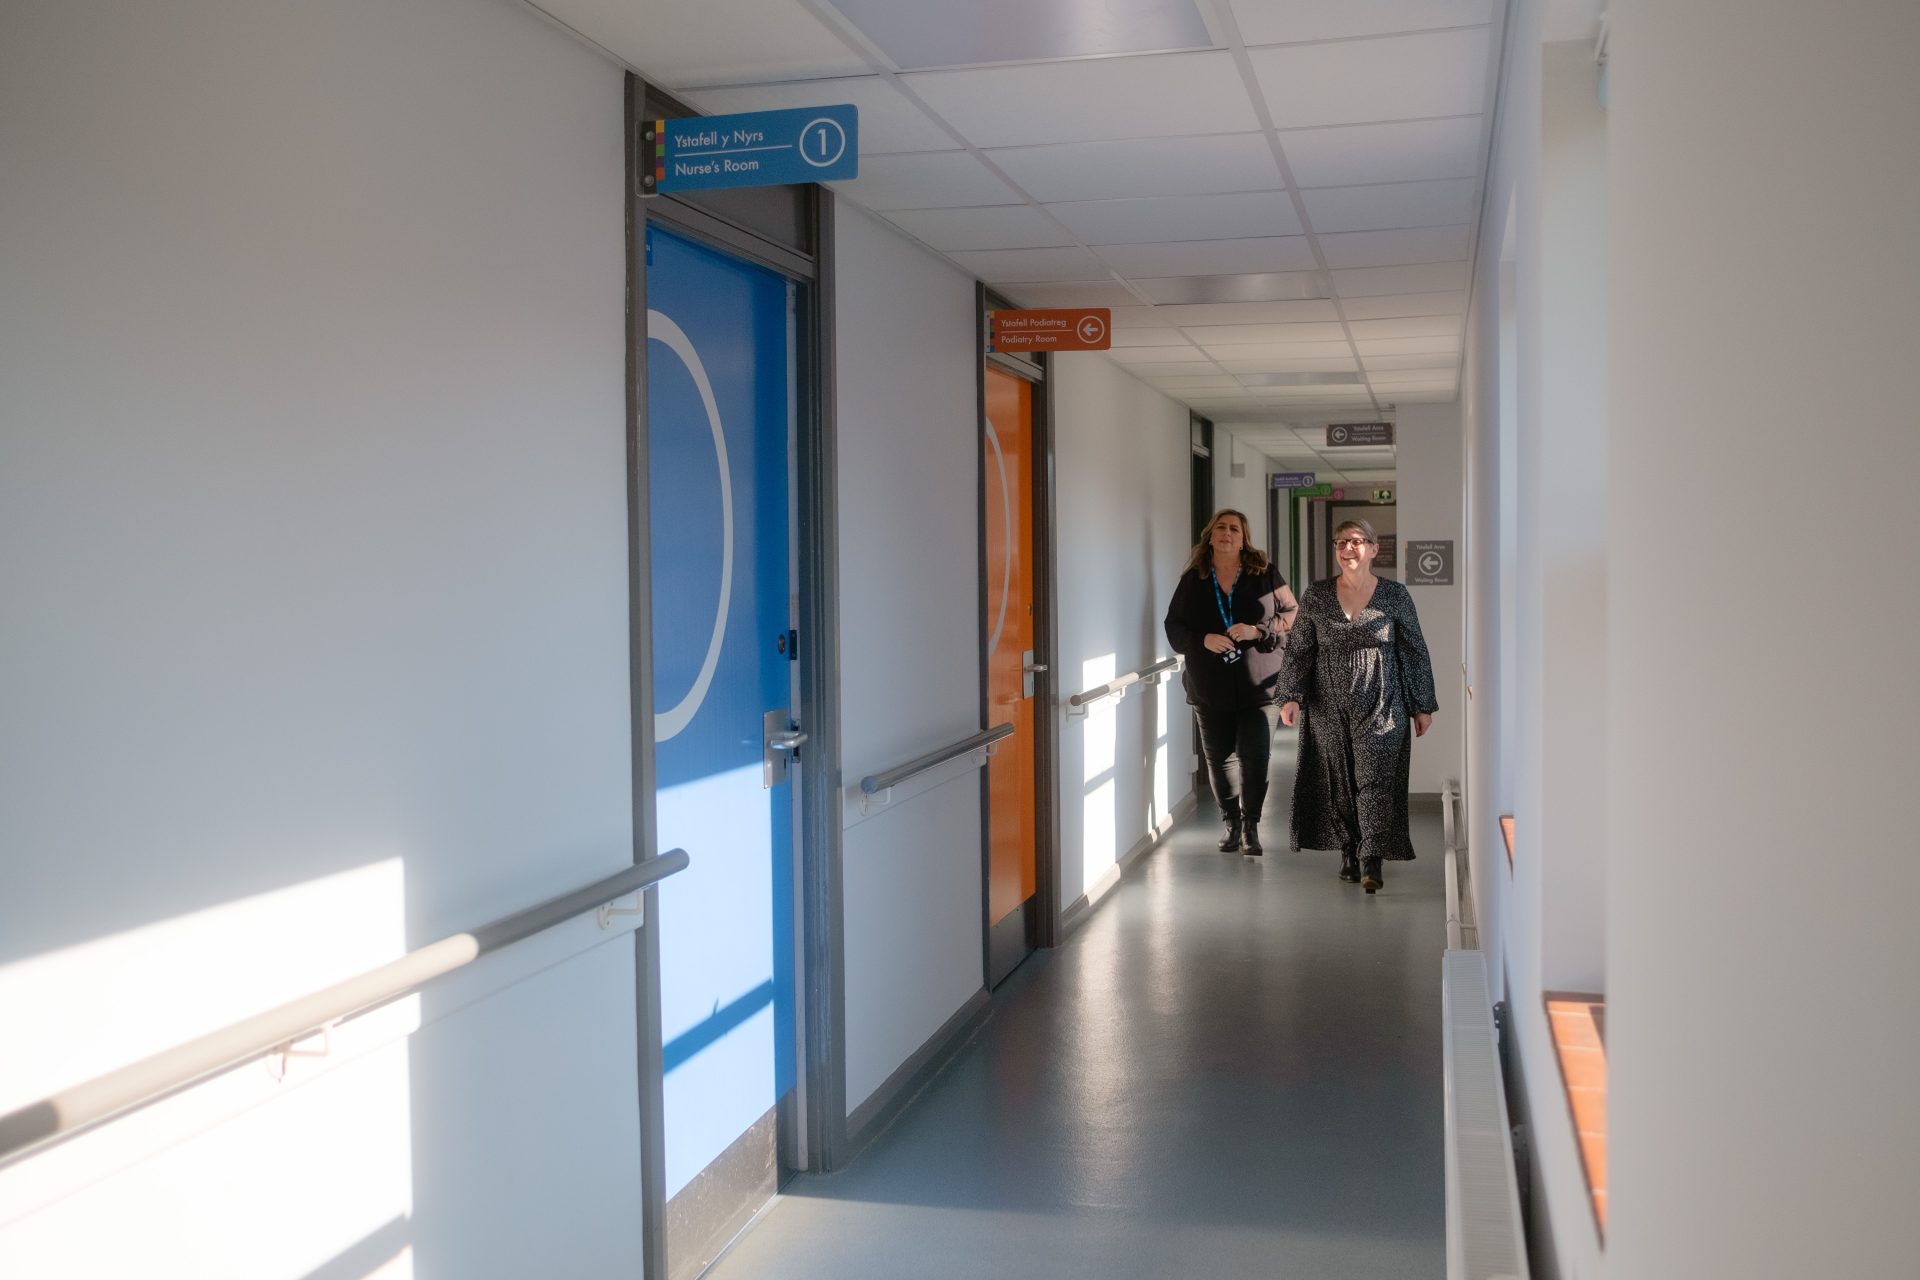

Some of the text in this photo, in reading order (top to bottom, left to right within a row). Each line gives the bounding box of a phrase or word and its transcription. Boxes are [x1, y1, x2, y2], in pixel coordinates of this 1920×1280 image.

[674, 130, 764, 148] Ystafell y Nyrs
[817, 128, 826, 156] 1
[675, 159, 759, 176] Nurse's Room
[1030, 319, 1067, 327] Podiatreg
[1001, 335, 1033, 344] Podiatry
